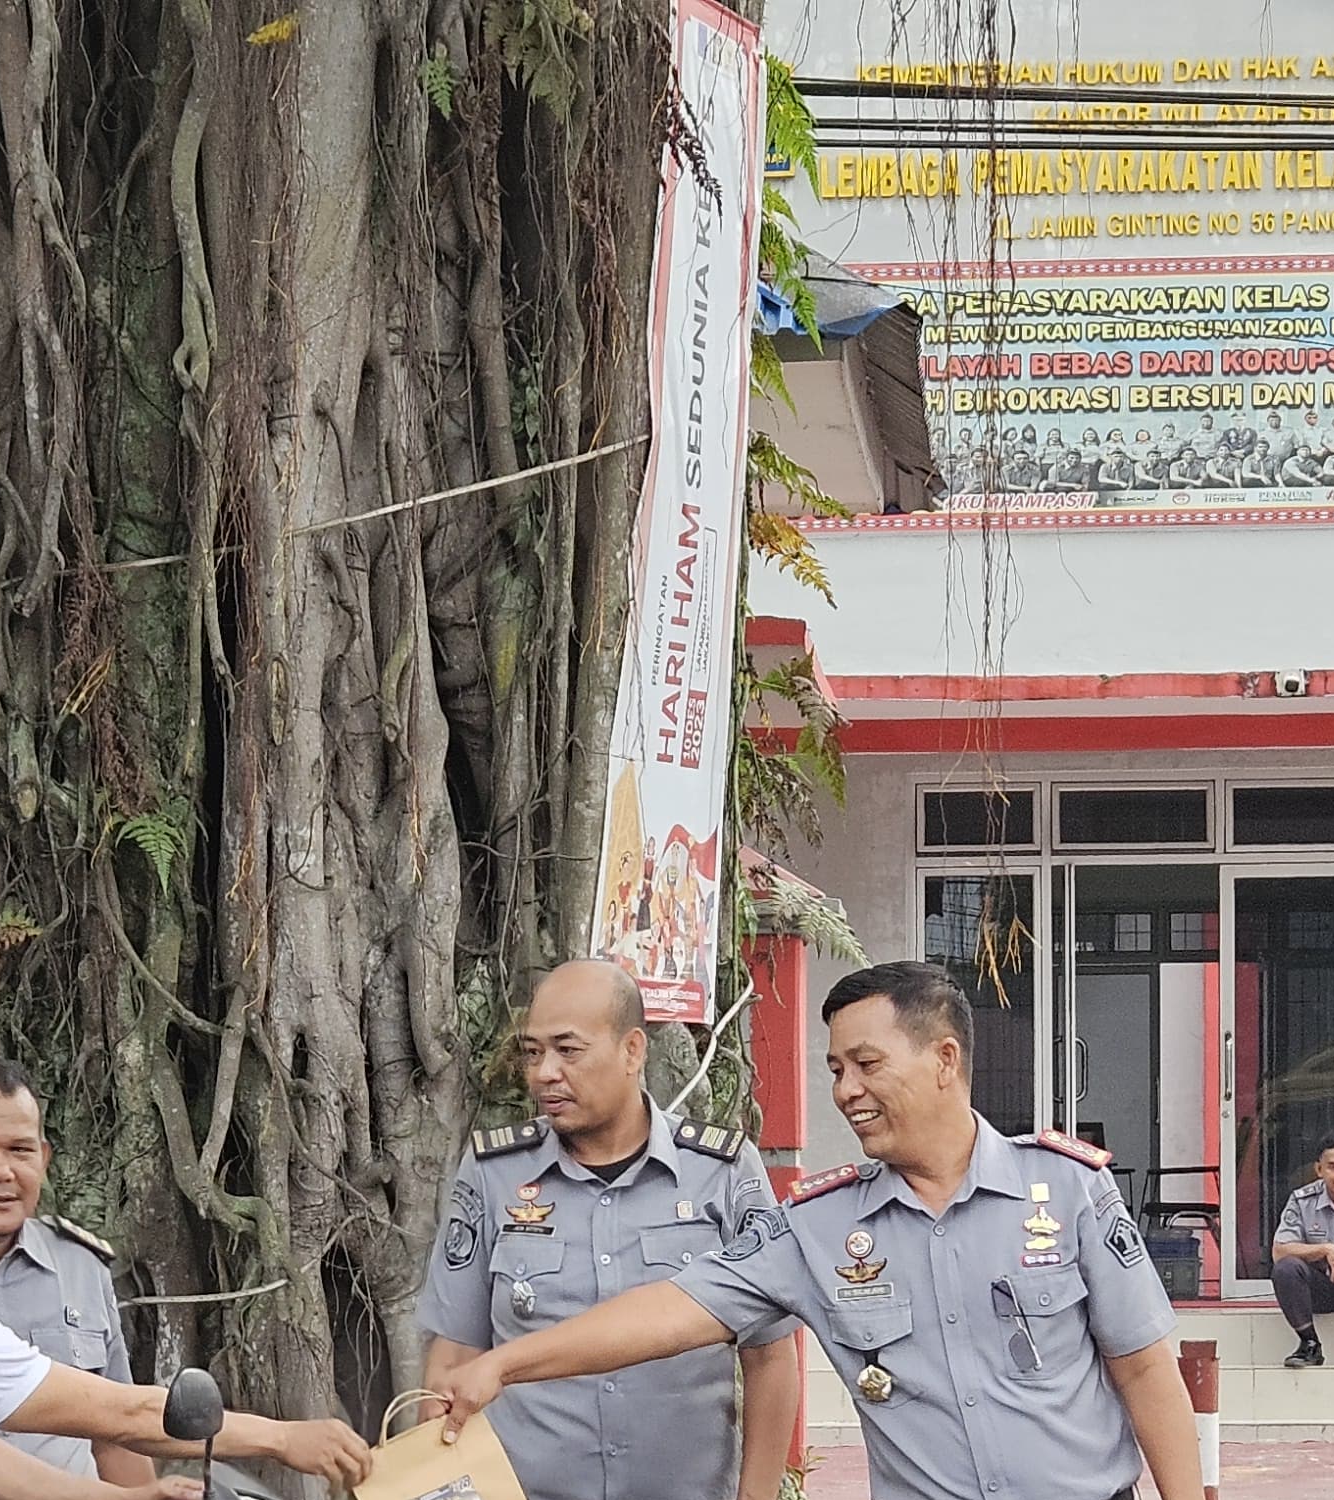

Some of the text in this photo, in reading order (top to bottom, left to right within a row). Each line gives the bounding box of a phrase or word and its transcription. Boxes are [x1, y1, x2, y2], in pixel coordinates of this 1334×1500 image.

[1066, 61, 1162, 85] HUKUM
[1174, 57, 1231, 83] DAN
[1243, 56, 1300, 80] HAK
[820, 151, 961, 198] LEMBAGA
[976, 149, 1262, 196] PEMASYARAKATAN
[1027, 213, 1097, 240] JAMIN
[1106, 212, 1200, 238] GINTING
[1208, 211, 1241, 235] NO
[1251, 211, 1275, 233] 56
[946, 286, 1226, 316] PEMASYARAKATAN
[1233, 284, 1329, 311] KELAS
[924, 323, 1082, 345] MEWUJUDKAN
[1087, 320, 1263, 343] PEMBANGUNAN
[1265, 318, 1327, 338] ZONA
[686, 262, 711, 489] SEDUNIA
[1029, 351, 1133, 378] BEBAS
[1140, 350, 1213, 376] DARI
[953, 386, 1120, 414] BIROKRASI
[1129, 383, 1244, 411] BERSIH
[1251, 381, 1315, 408] DAN
[670, 502, 701, 628] HAM
[651, 574, 669, 687] PERINGATAN
[655, 641, 688, 765] HARI
[689, 698, 706, 763] 2023
[682, 737, 694, 761] 10
